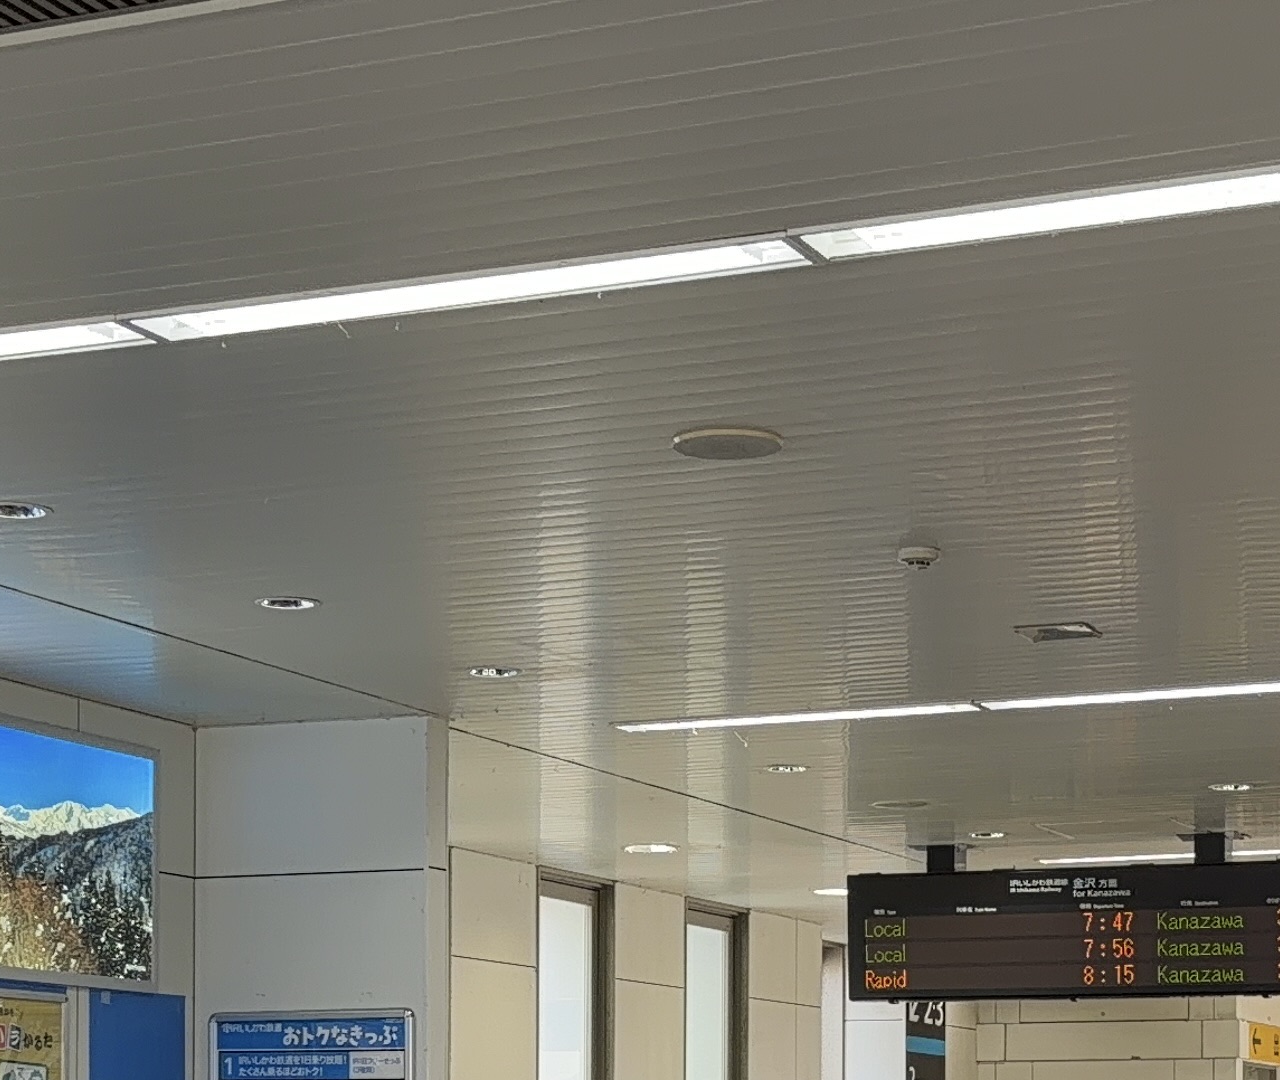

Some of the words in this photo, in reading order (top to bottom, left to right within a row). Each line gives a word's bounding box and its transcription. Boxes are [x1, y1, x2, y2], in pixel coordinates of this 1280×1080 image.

[1072, 877, 1096, 890] 金沢
[1073, 890, 1086, 898] for
[1087, 889, 1132, 898] Kanazawa
[864, 918, 906, 938] Local
[1082, 911, 1134, 932] 7:47
[1156, 911, 1244, 931] Kanazawa
[865, 943, 906, 964] Local
[1083, 938, 1135, 959] 7:56
[1157, 938, 1244, 957] Kanazawa
[865, 969, 907, 990] Rapid
[1083, 964, 1135, 985] 8:15
[1157, 964, 1244, 984] Kanazawa
[282, 1025, 398, 1046] おトクなきっぷ
[224, 1057, 233, 1075] 1
